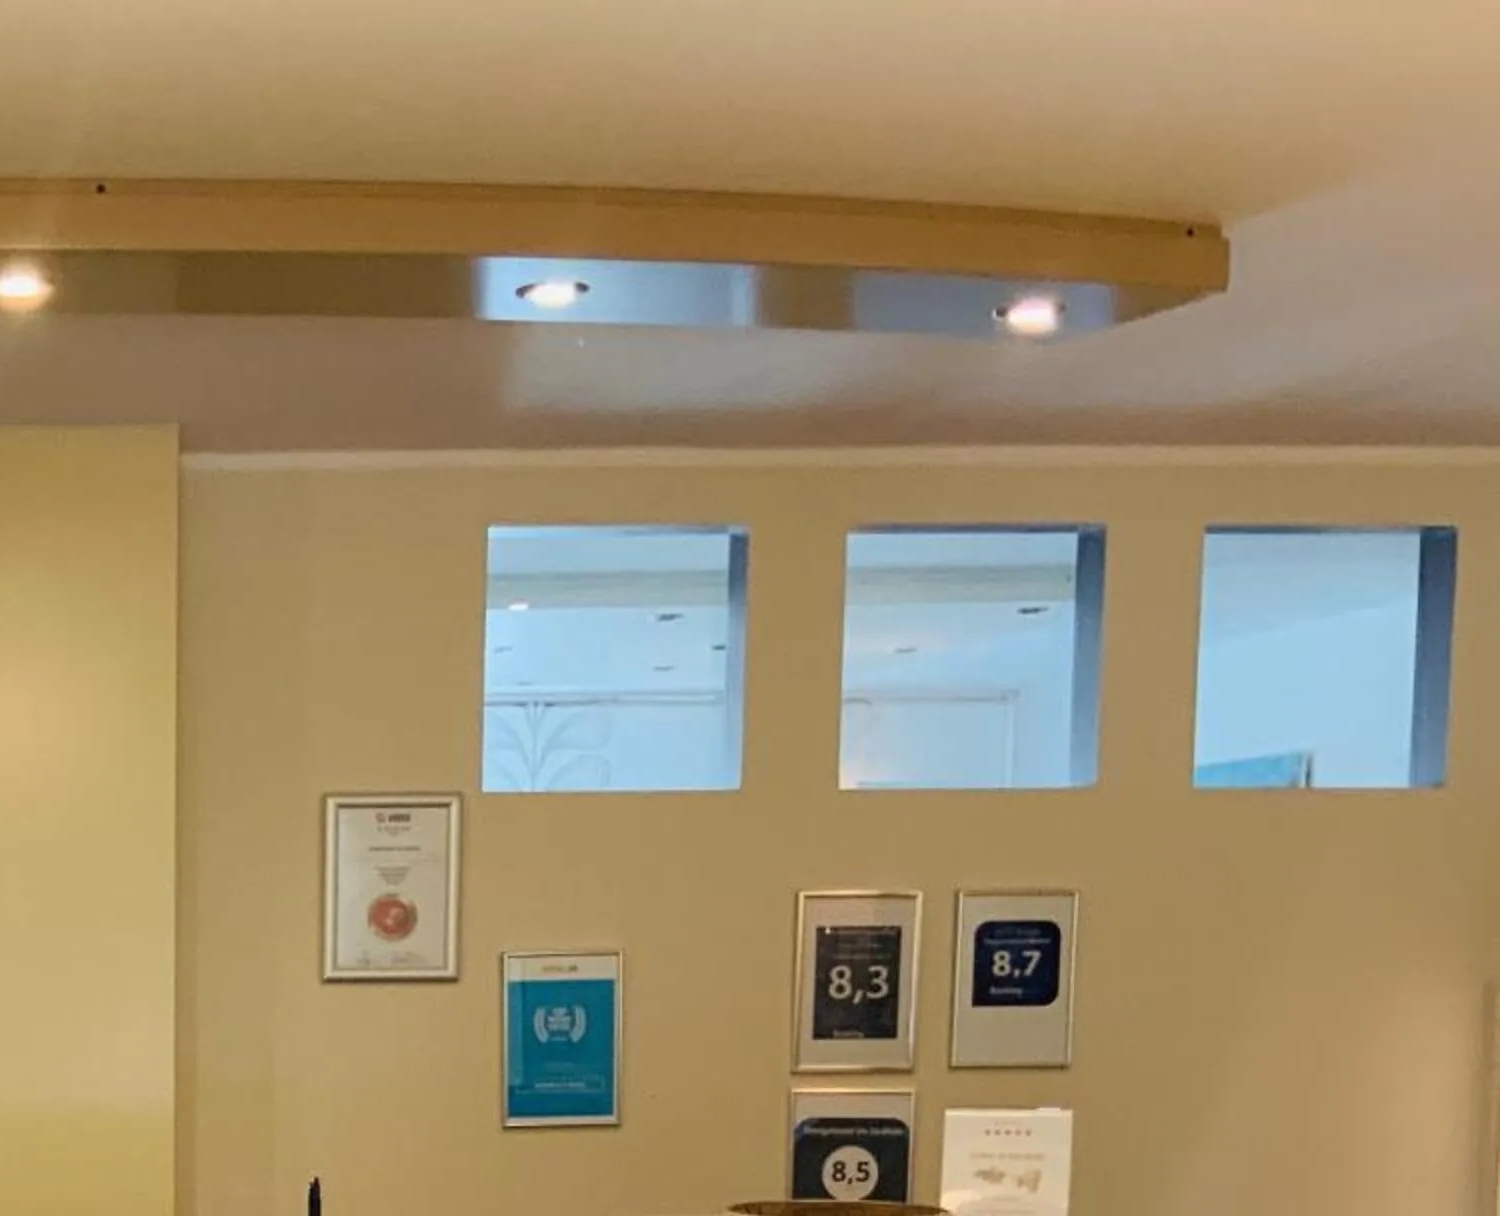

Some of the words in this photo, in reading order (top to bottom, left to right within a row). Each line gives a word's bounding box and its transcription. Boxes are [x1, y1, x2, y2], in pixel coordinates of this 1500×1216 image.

[992, 950, 1042, 979] 8,7
[828, 964, 889, 1005] 8,3
[831, 1160, 871, 1185] 8,5
